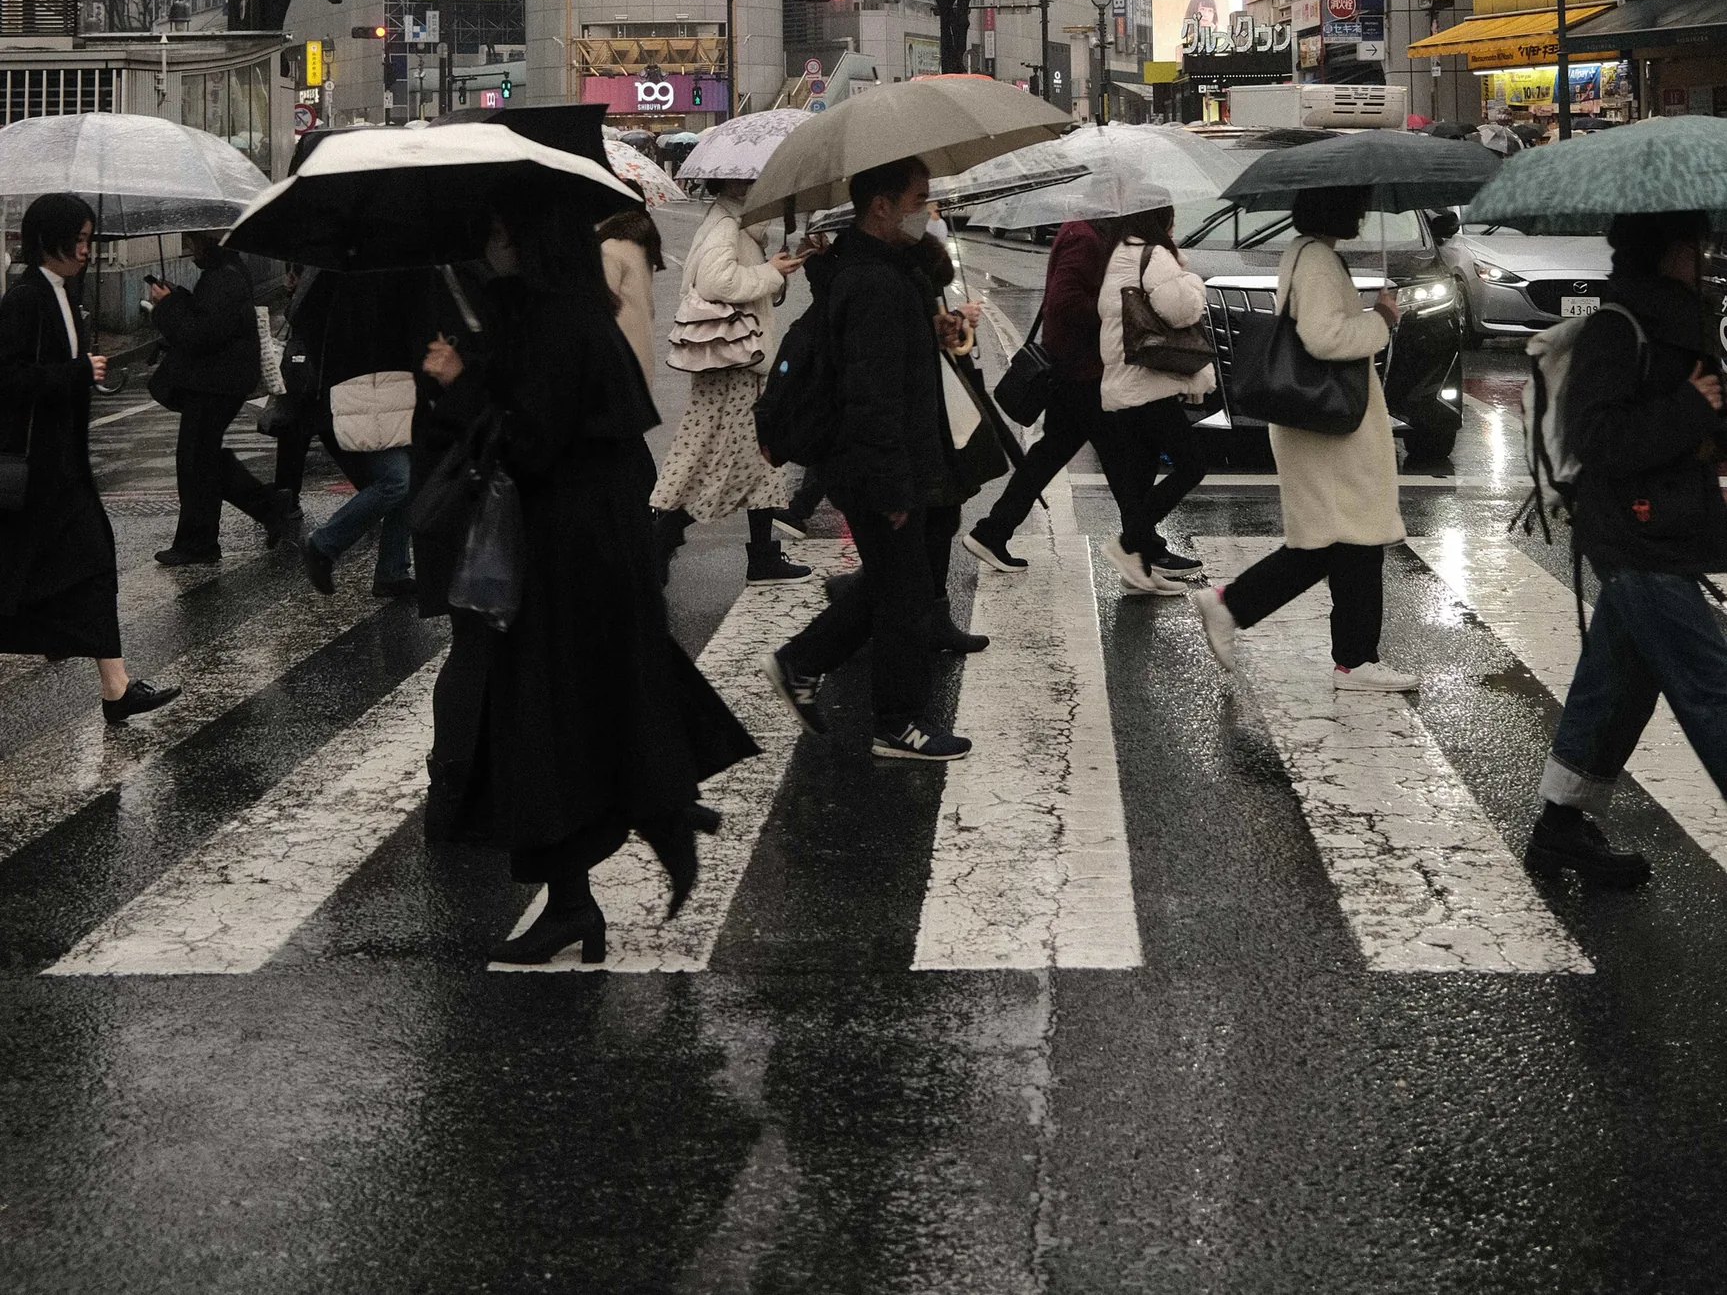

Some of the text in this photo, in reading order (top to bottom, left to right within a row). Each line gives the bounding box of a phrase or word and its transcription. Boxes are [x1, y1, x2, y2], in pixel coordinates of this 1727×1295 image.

[1181, 11, 1292, 55] グルメタウン
[634, 81, 675, 110] 109
[637, 103, 661, 111] SHIBUYA
[904, 728, 930, 751] N
